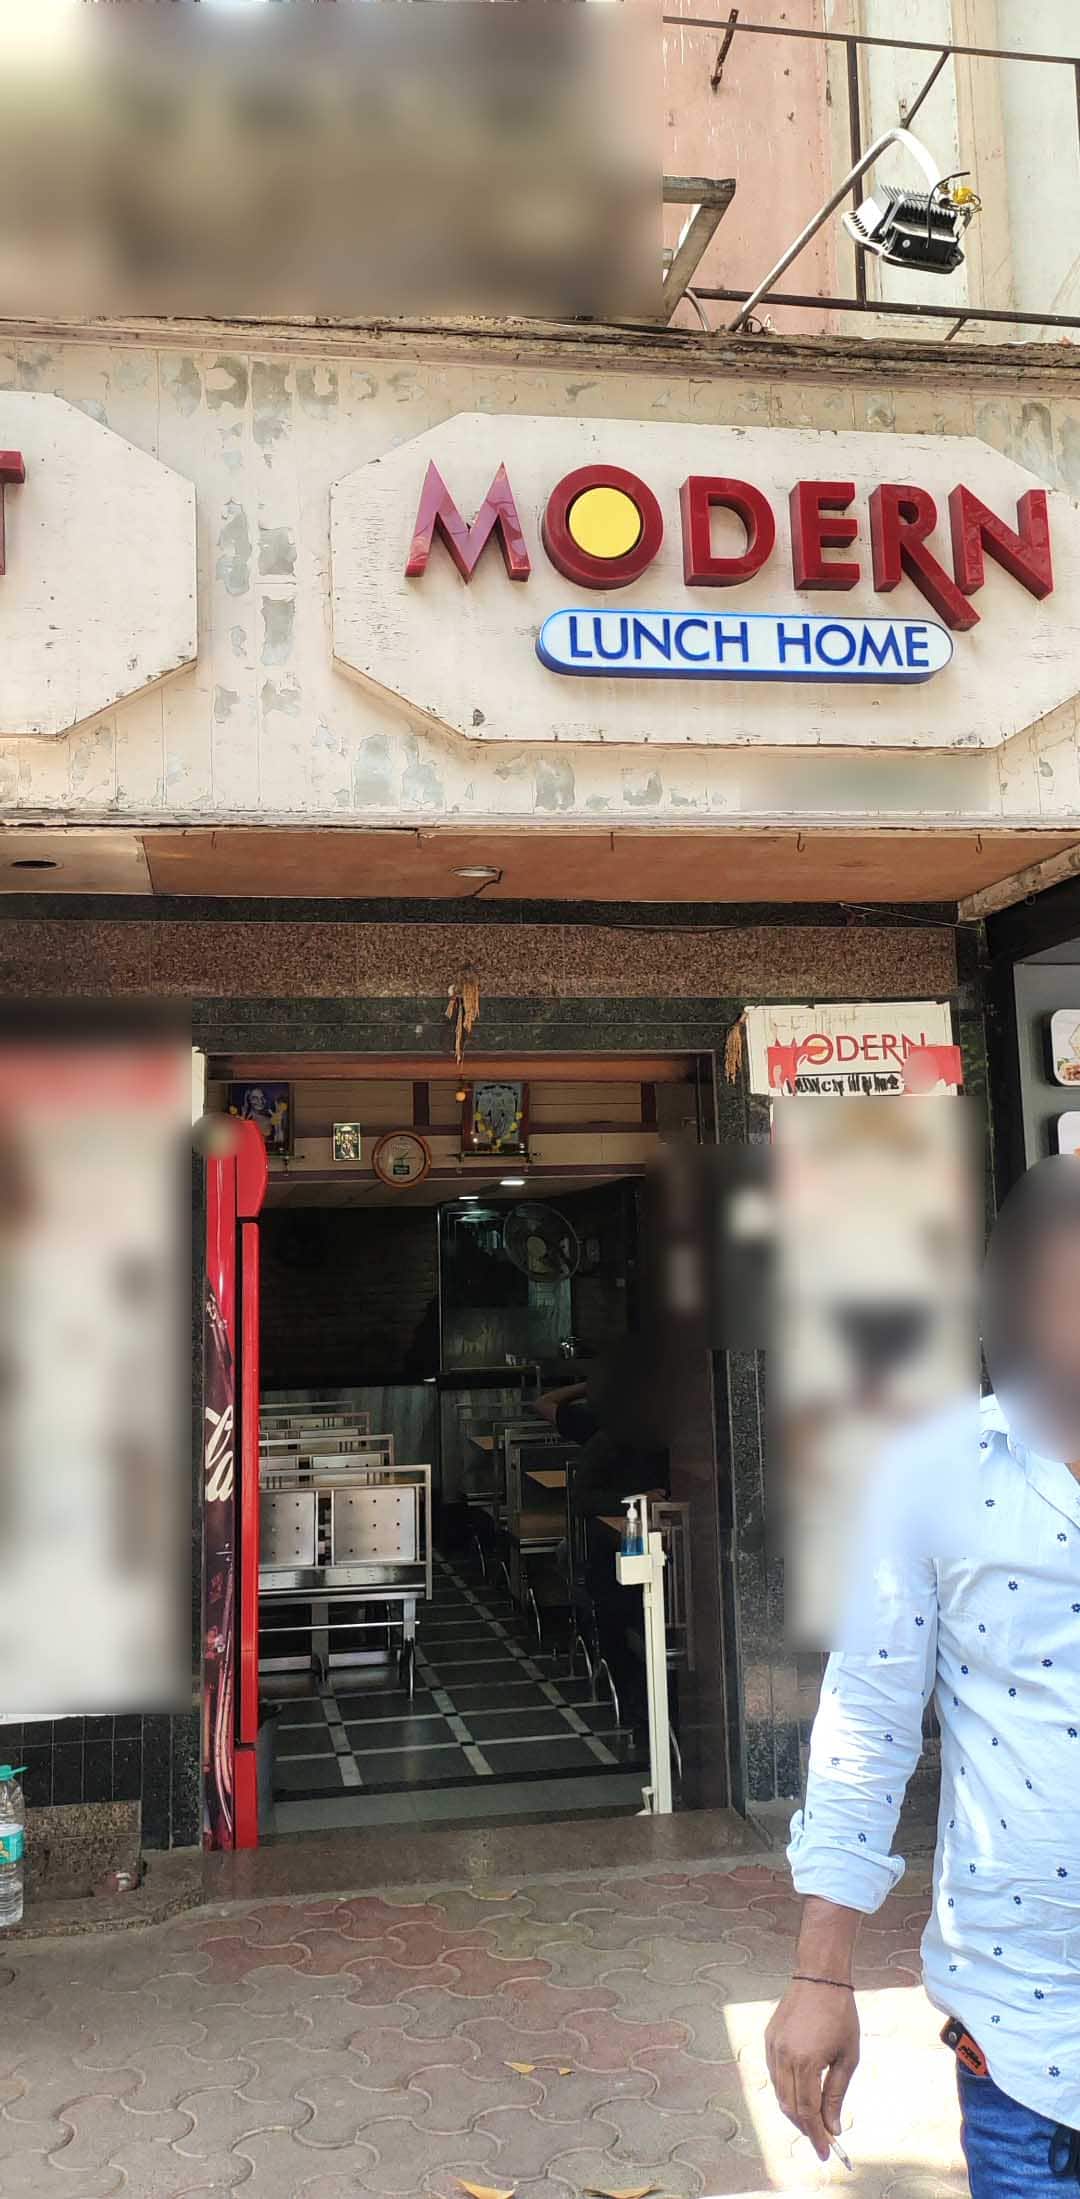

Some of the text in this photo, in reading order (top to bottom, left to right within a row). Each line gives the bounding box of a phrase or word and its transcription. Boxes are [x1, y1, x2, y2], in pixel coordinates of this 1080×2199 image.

[404, 460, 1054, 631] MODERN
[568, 615, 929, 668] LUNCH HOME
